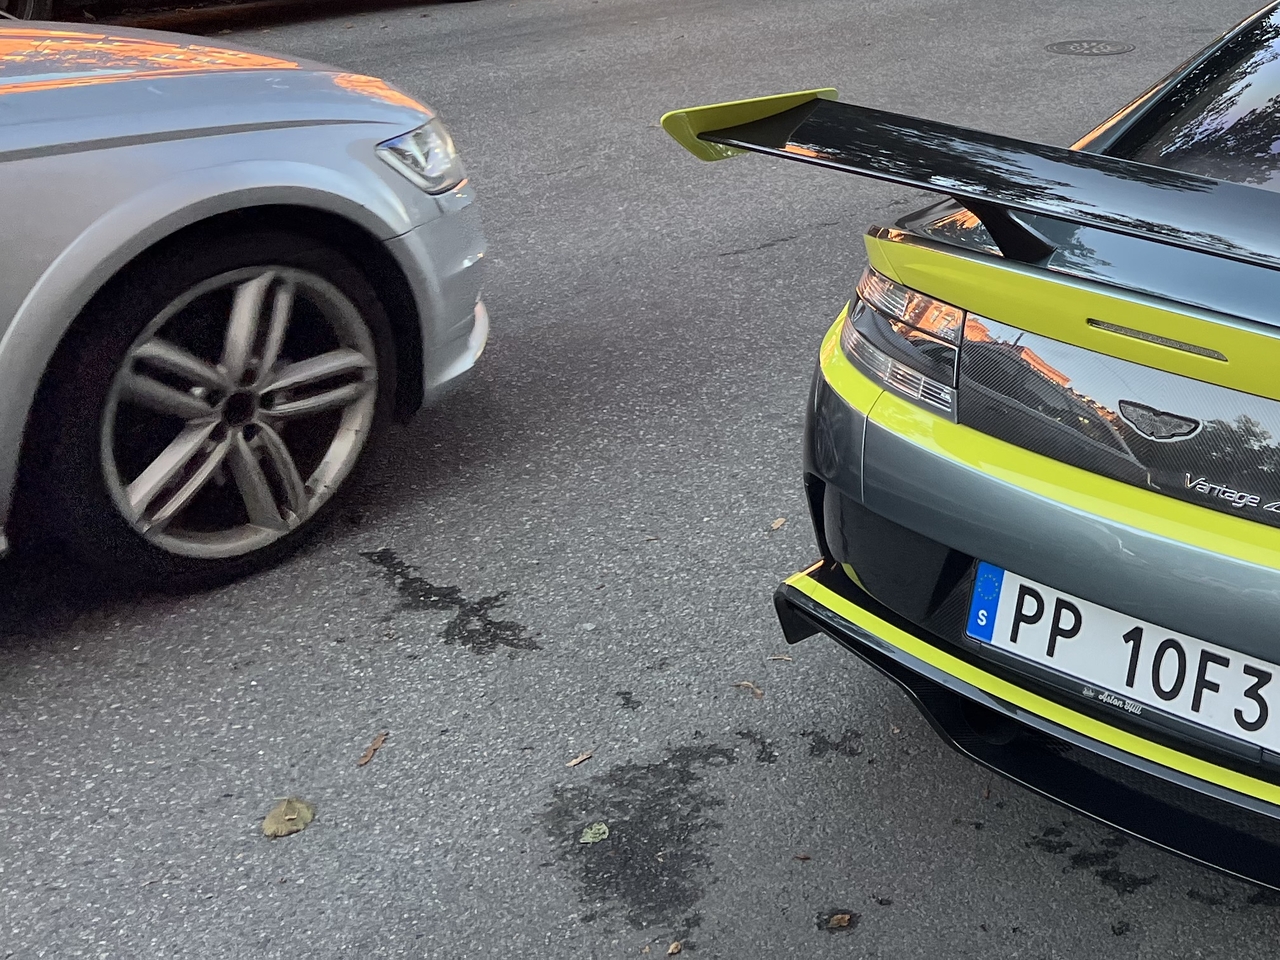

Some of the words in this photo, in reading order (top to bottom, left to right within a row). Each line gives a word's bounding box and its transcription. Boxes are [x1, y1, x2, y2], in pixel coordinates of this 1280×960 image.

[1185, 472, 1261, 508] Vantage
[977, 609, 988, 627] S
[1010, 583, 1082, 658] PP
[1122, 626, 1273, 732] 10F3
[1098, 691, 1124, 708] Aston
[1124, 699, 1142, 715] Hill
